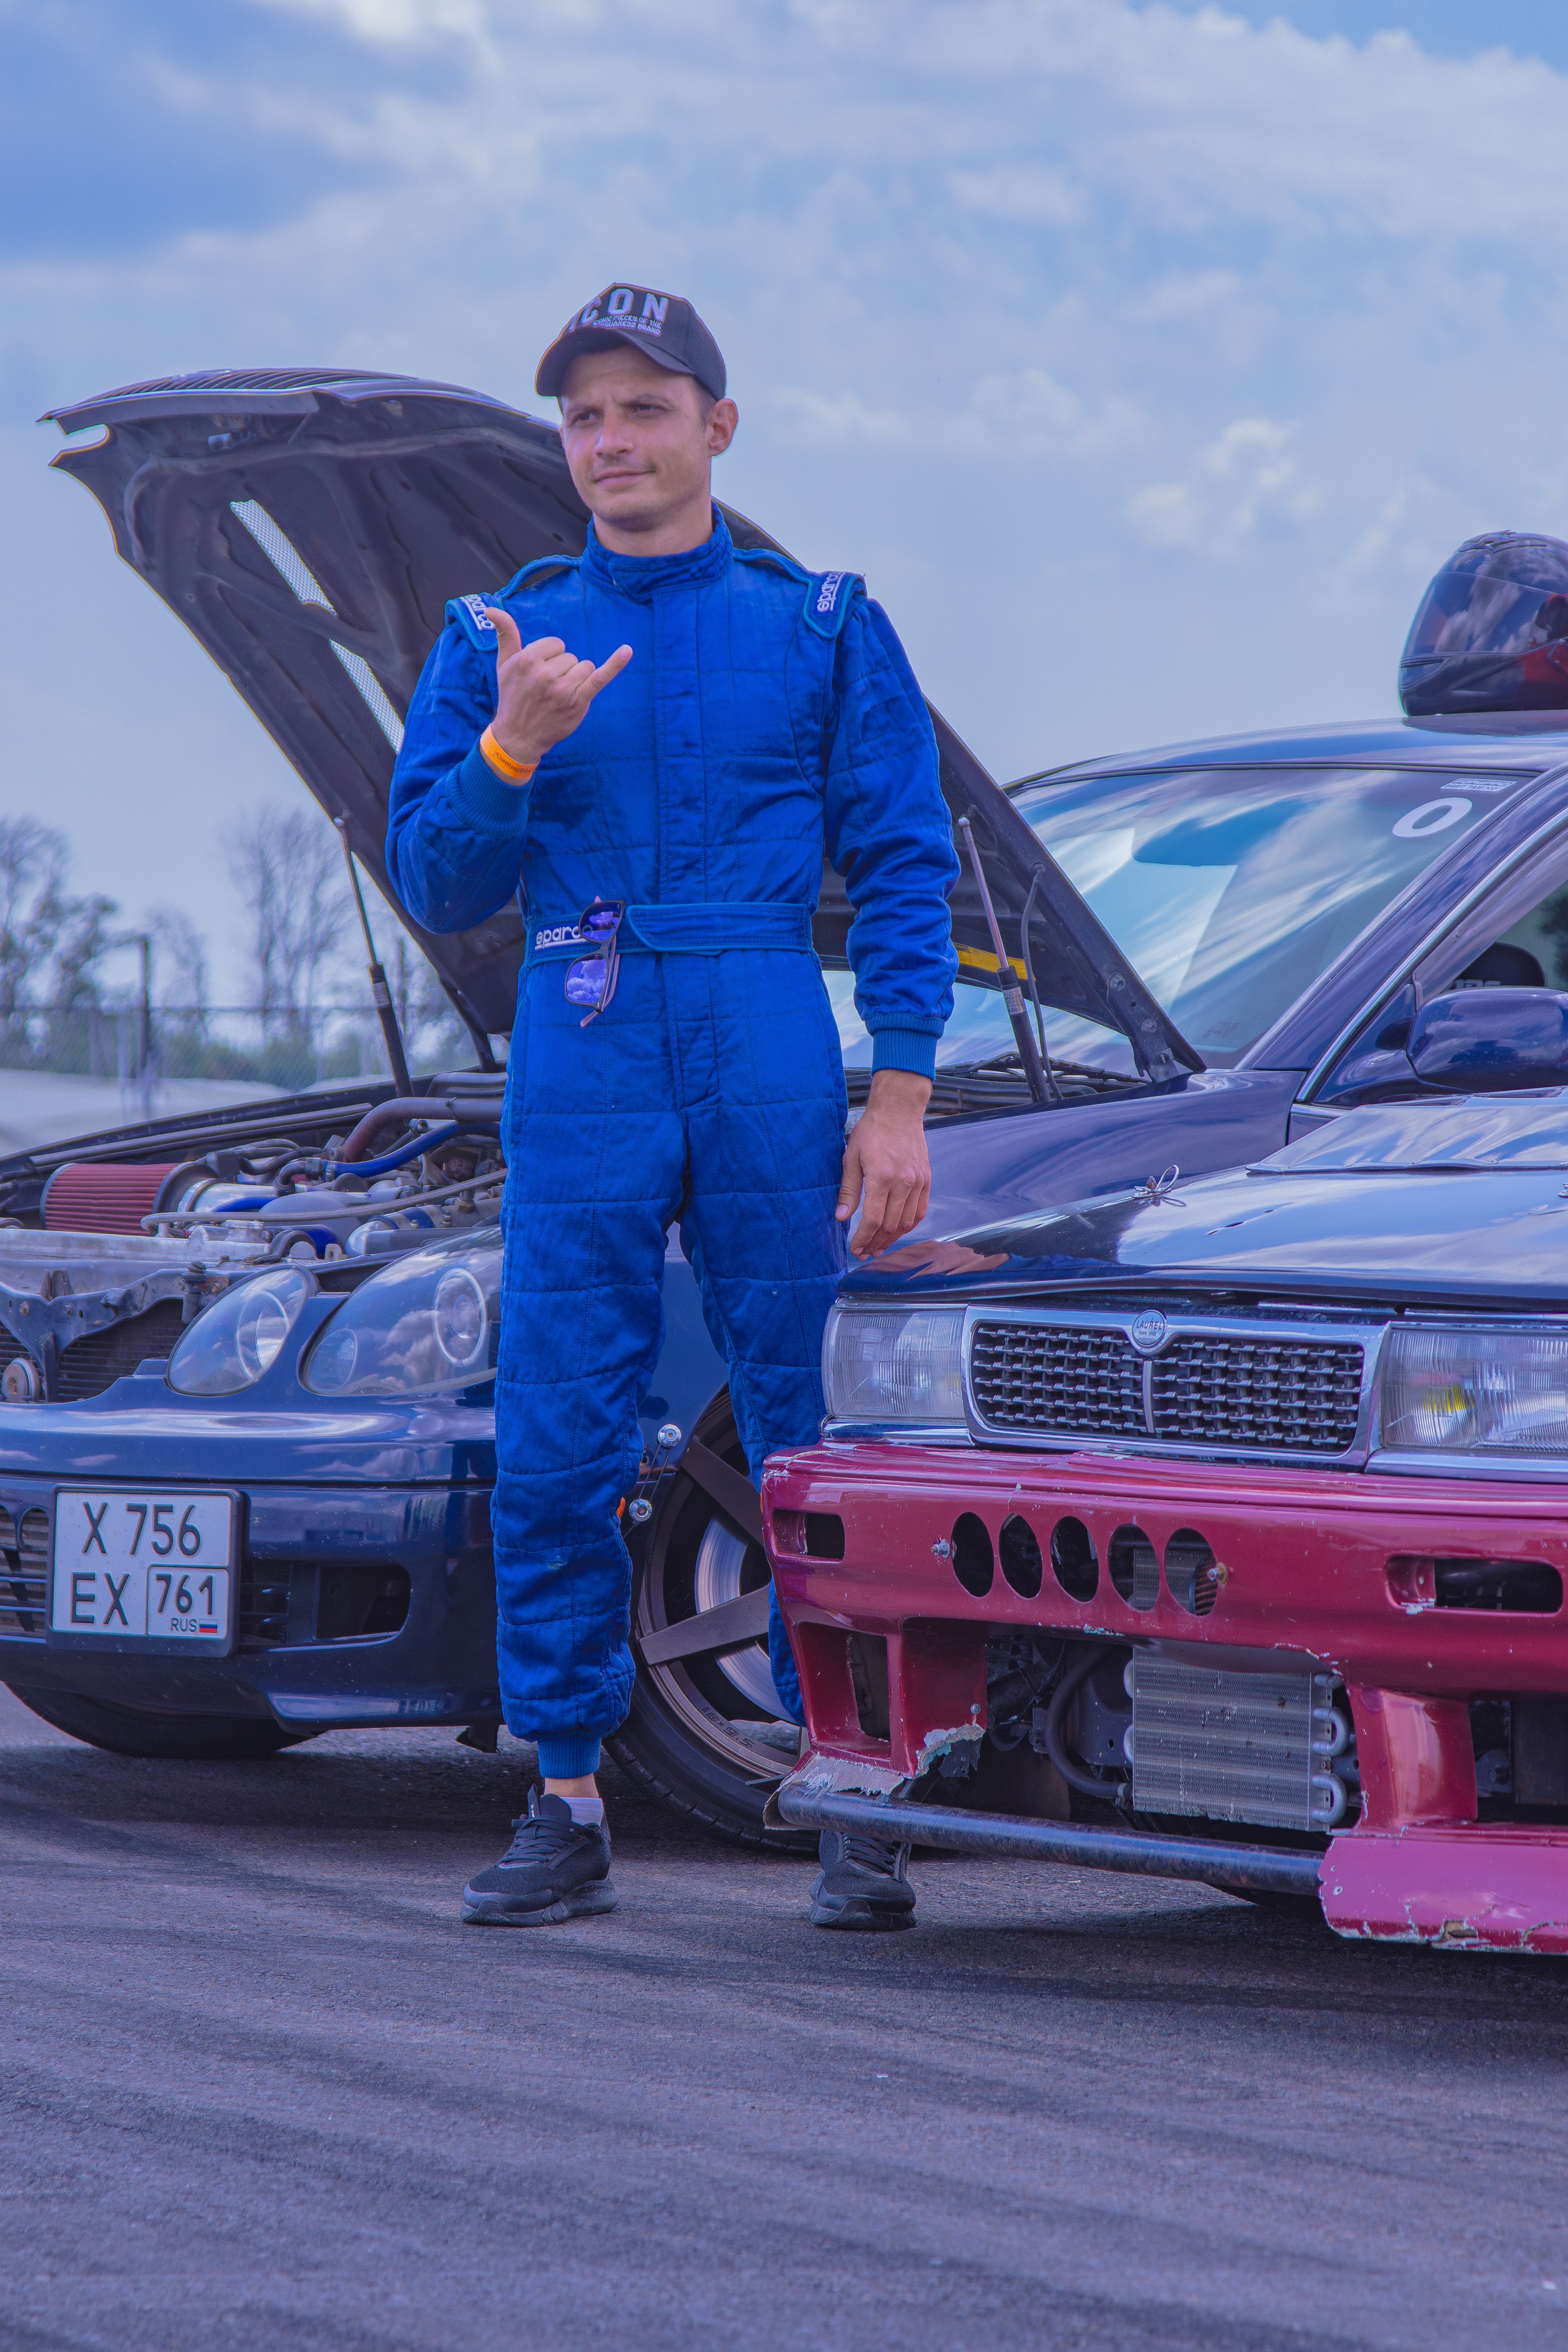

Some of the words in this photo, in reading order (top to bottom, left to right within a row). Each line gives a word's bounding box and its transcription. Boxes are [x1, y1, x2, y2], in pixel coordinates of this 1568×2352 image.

[567, 288, 669, 331] ICON
[592, 315, 612, 326] ICONIC
[649, 319, 662, 330] THE
[637, 323, 661, 335] BRAND
[1136, 1320, 1162, 1330] LAUREL
[126, 1503, 201, 1556] 756
[155, 1573, 213, 1615] 761
[170, 1618, 197, 1632] RUS
